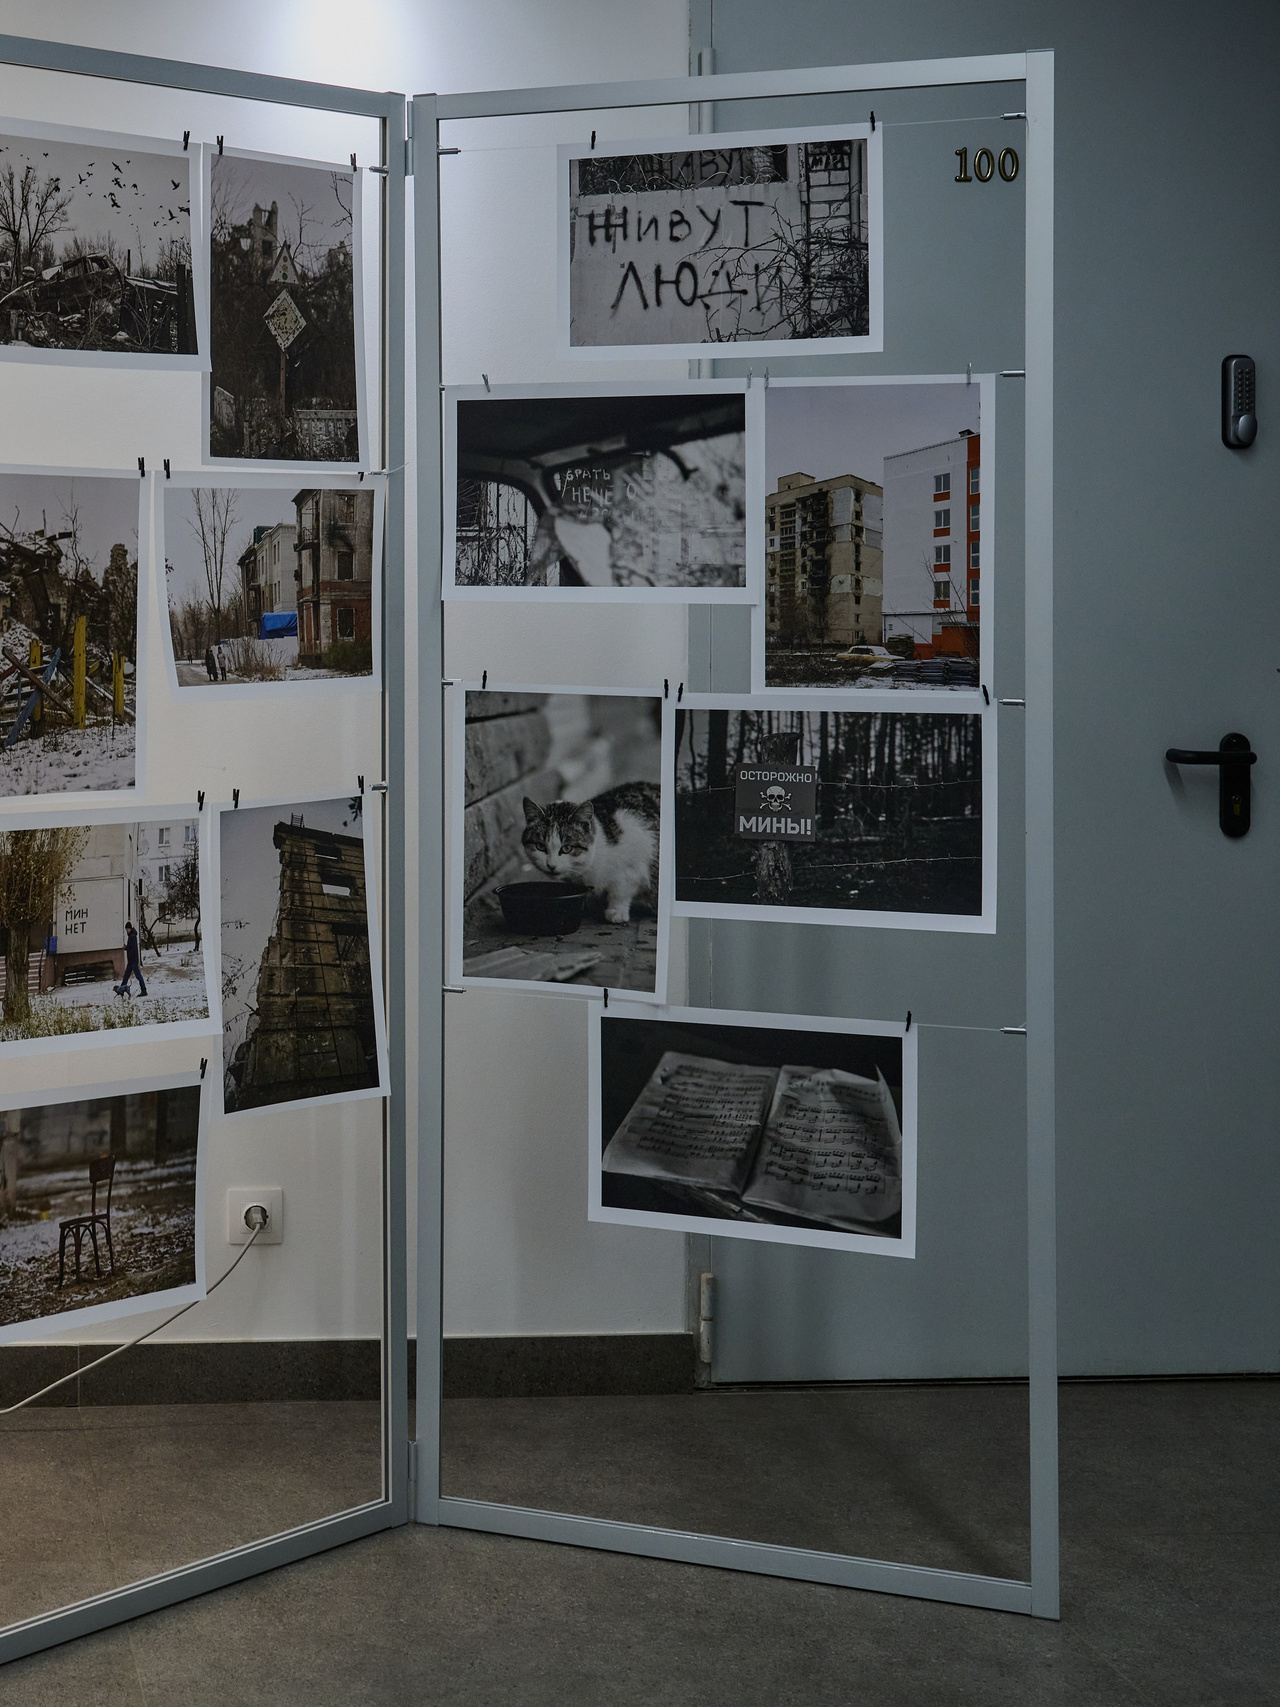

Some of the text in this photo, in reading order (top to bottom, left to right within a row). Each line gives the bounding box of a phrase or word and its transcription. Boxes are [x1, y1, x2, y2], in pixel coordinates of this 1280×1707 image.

[954, 147, 1019, 182] 100
[612, 260, 783, 314] ЛЮДИ
[572, 482, 637, 507] НЕЧЕО
[739, 770, 812, 783] ОСТОРОЖНО
[739, 816, 812, 835] МИНЫ!
[65, 908, 89, 921] МИН
[65, 922, 87, 935] НЕТ
